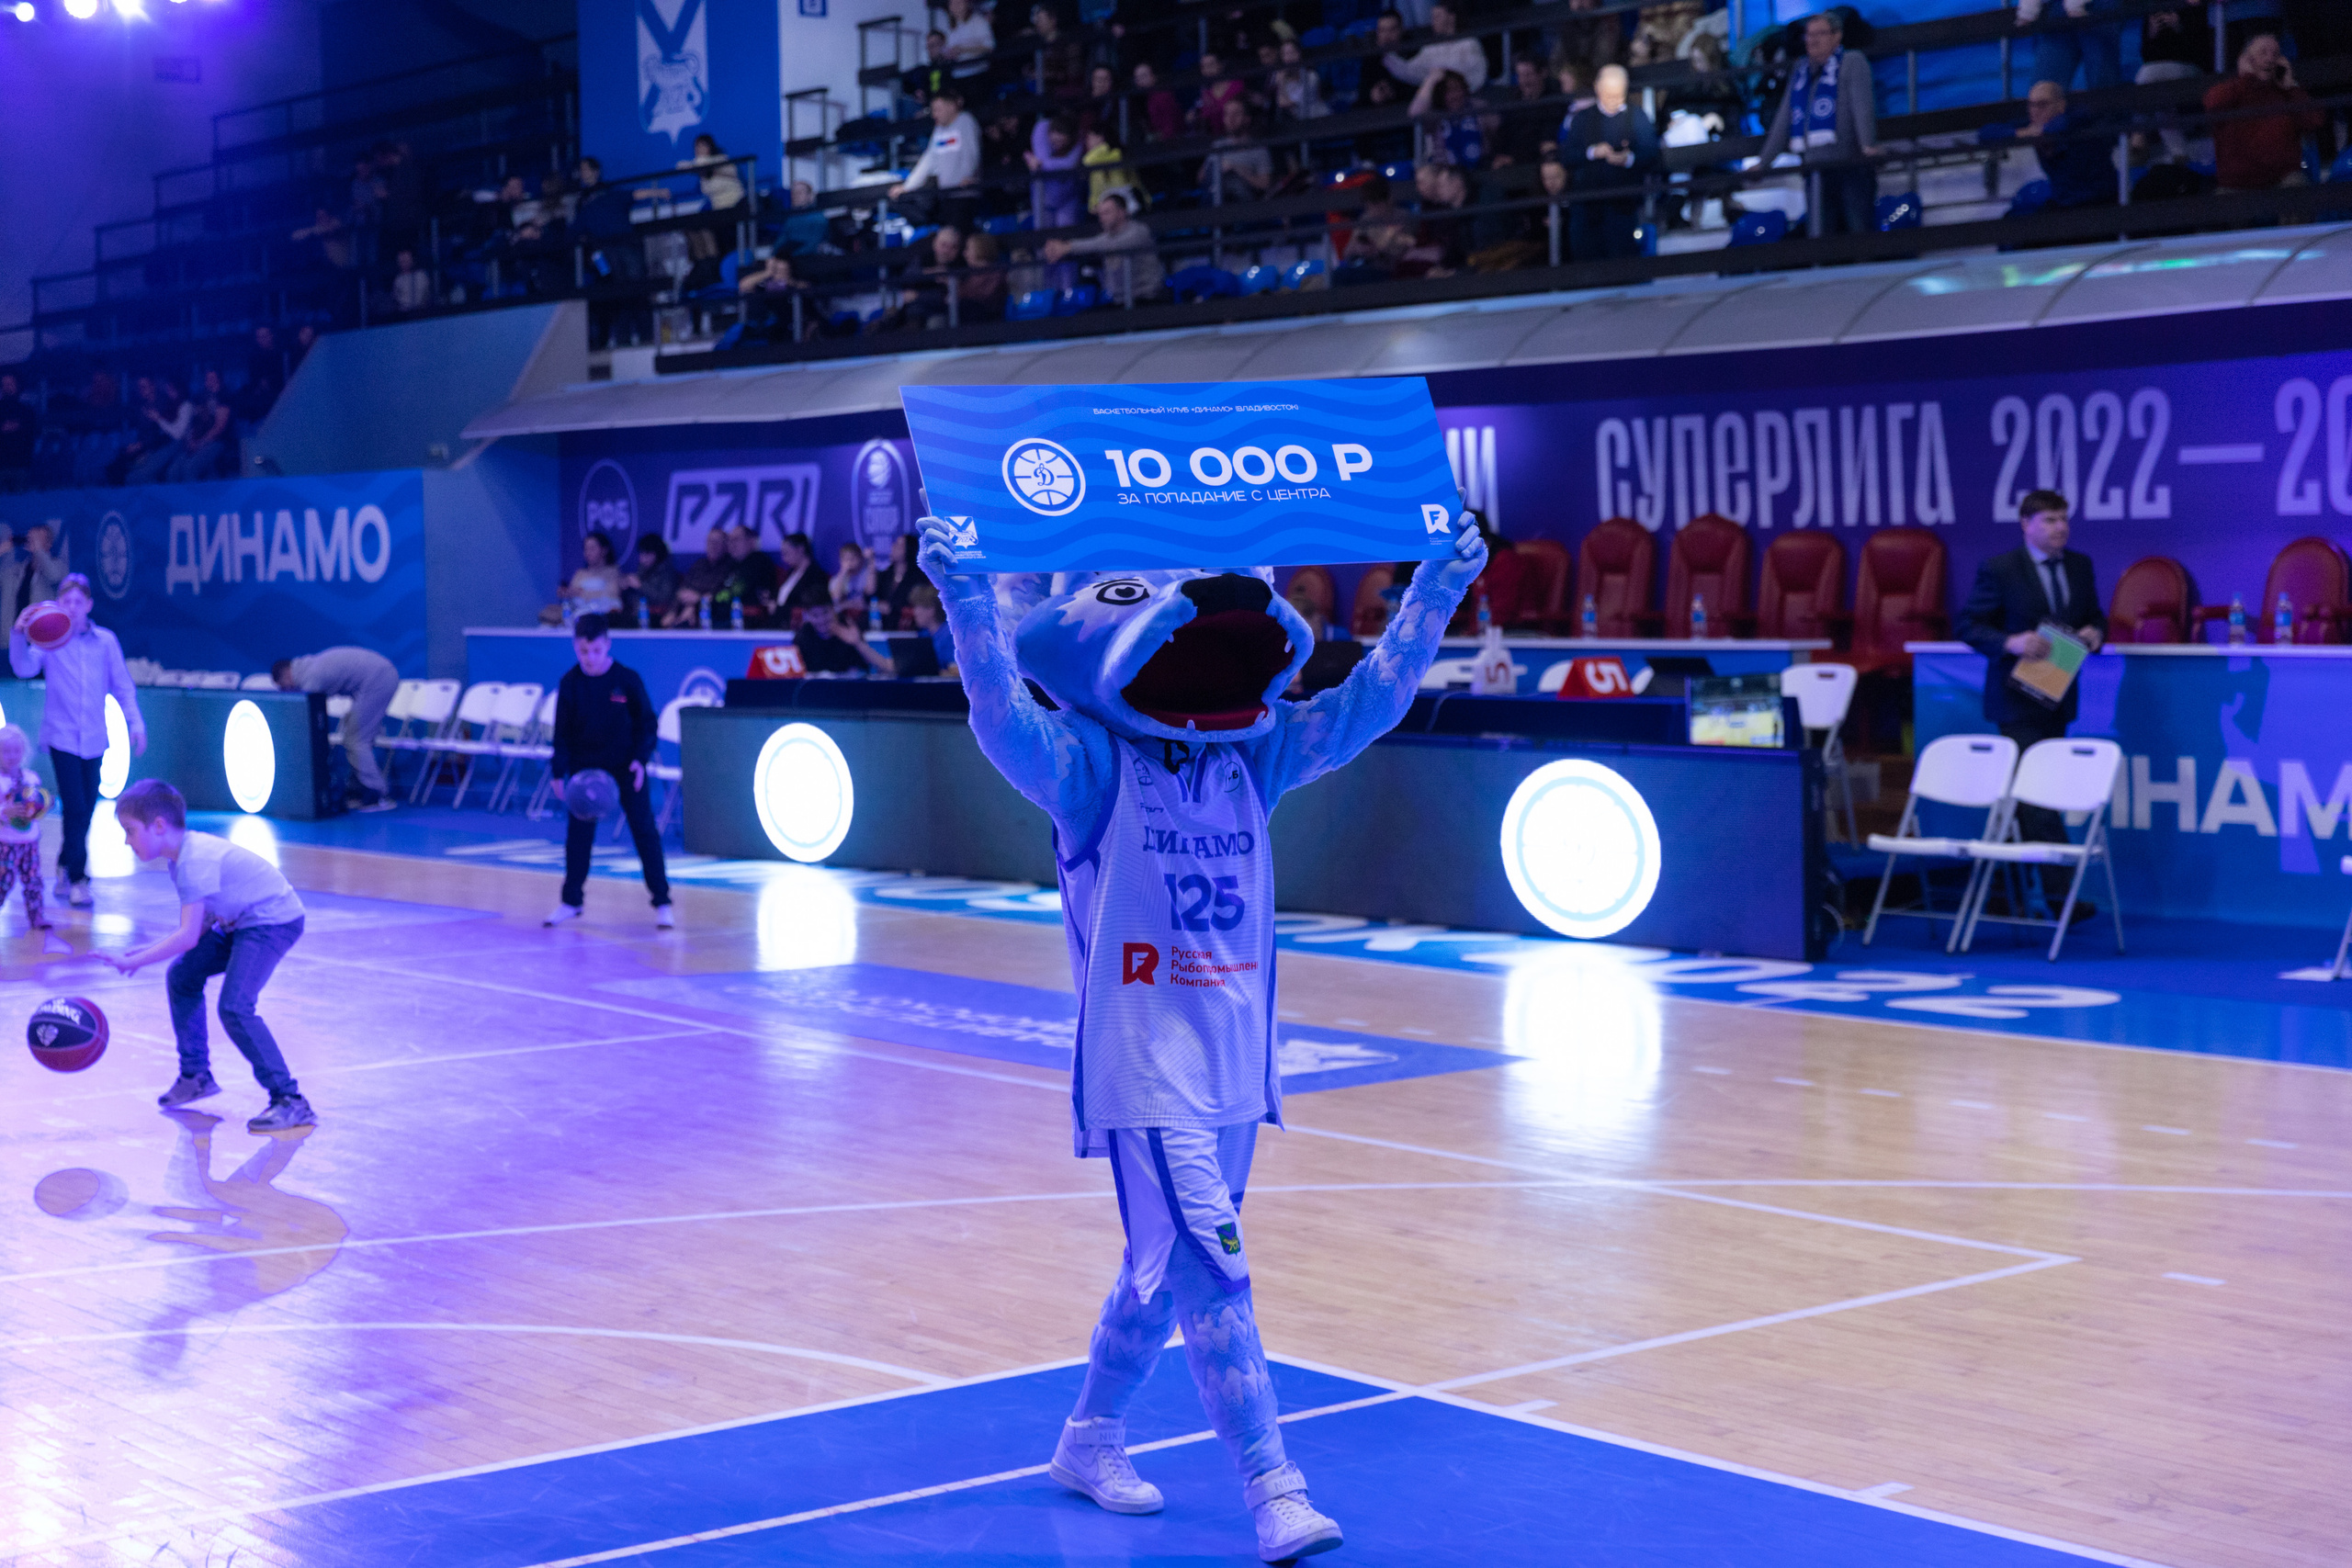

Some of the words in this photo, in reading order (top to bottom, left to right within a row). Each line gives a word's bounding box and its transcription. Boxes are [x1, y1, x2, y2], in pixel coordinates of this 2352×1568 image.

[1092, 406, 1165, 415] БАСКЕТБОЛЬНЫЙ
[1104, 448, 1171, 488] 10
[1190, 445, 1317, 486] 000
[1116, 492, 1141, 504] ЗА
[1144, 491, 1247, 504] ПОПАДАНИЕ
[1251, 490, 1263, 502] С
[1266, 487, 1331, 502] ЦЕНТРА
[165, 503, 391, 595] ДИНАМО
[1164, 873, 1246, 932] 125
[1273, 1475, 1304, 1491] NIKE
